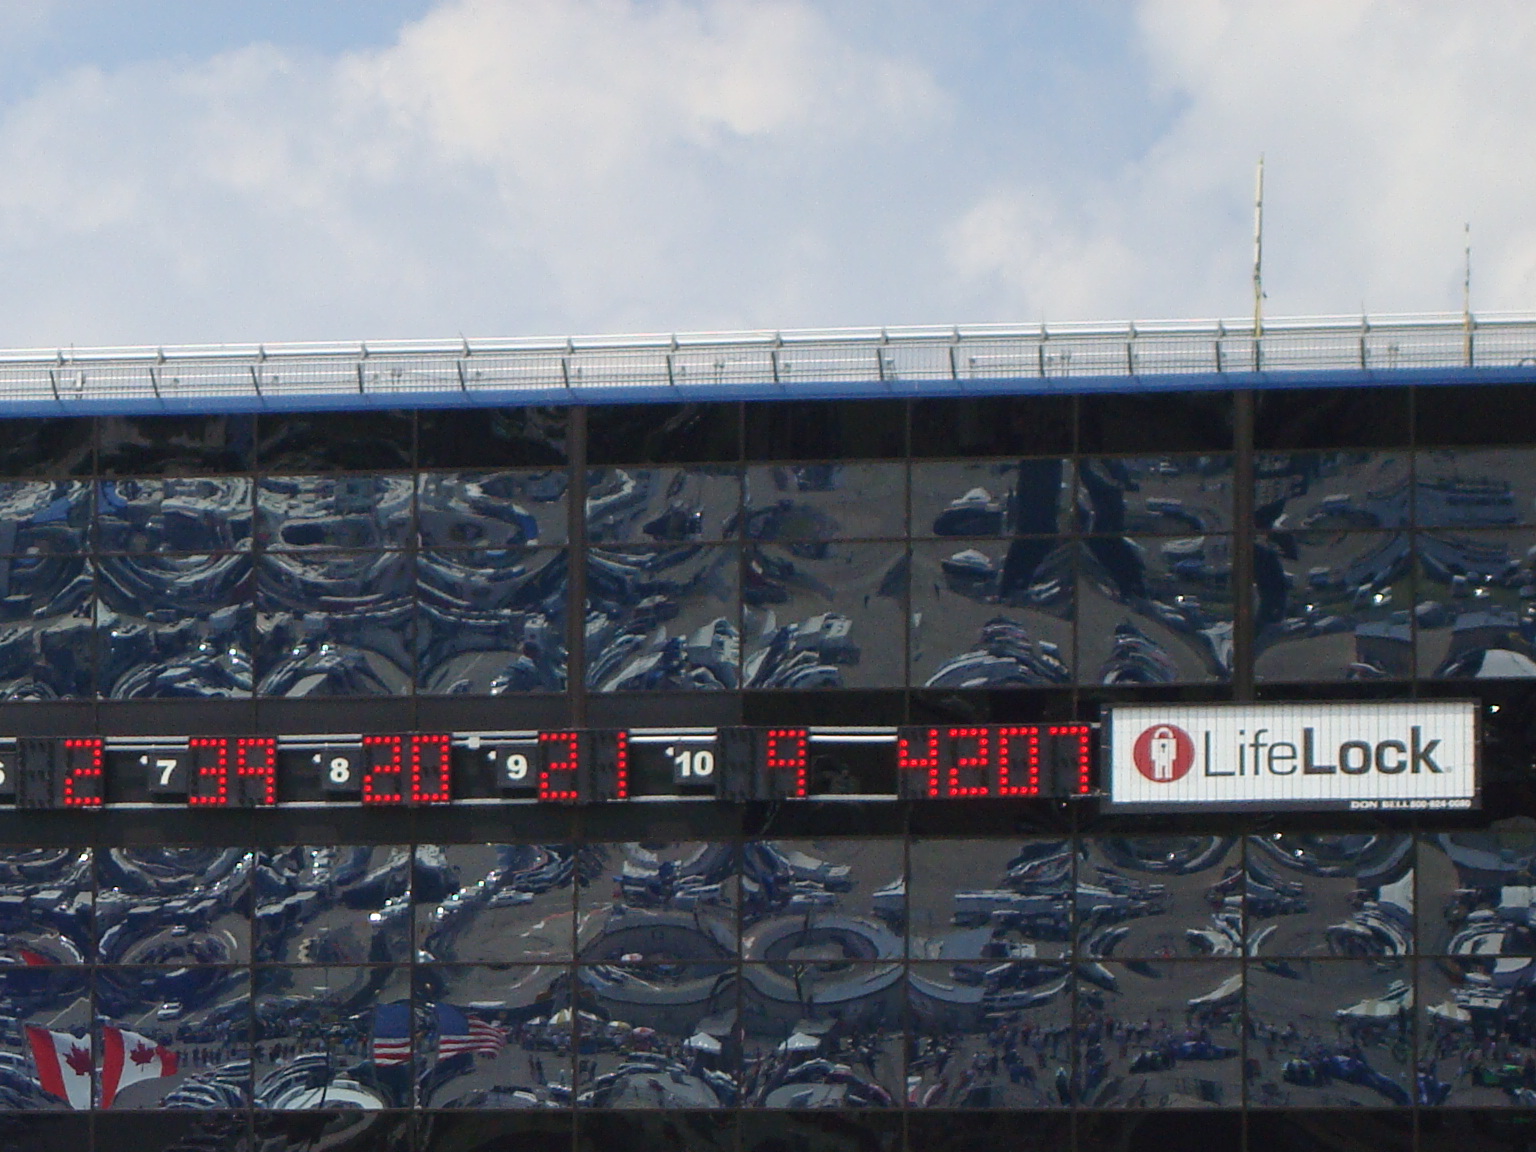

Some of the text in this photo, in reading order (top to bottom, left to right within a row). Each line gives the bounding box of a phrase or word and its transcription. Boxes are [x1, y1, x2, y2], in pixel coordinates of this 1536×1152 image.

[65, 739, 102, 805] 2
[156, 759, 178, 785] 7
[188, 738, 276, 804] 39
[329, 757, 351, 783] 8
[364, 735, 450, 802] 20
[506, 754, 528, 780] 9
[675, 750, 714, 777] 10
[768, 729, 806, 797] 9
[899, 726, 1090, 798] 4207
[1204, 725, 1446, 778] LifeLock
[1350, 801, 1379, 809] DON
[1382, 800, 1409, 808] BELL
